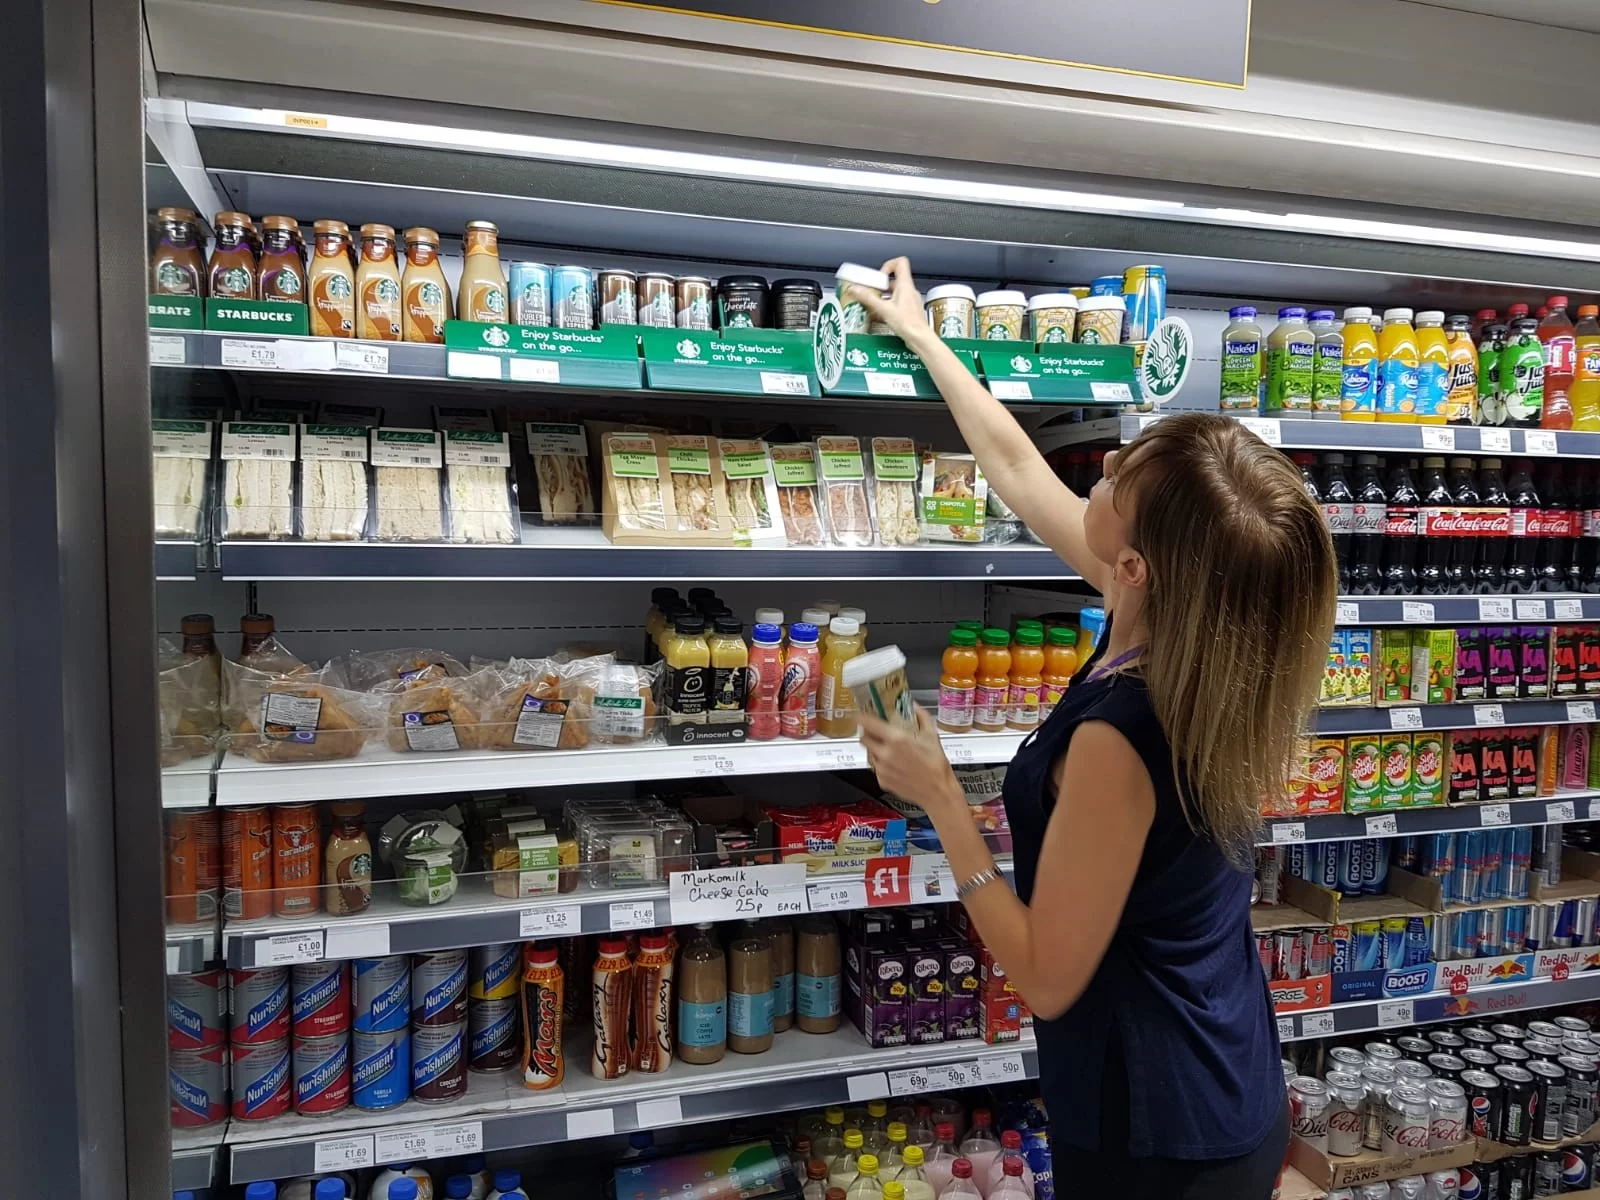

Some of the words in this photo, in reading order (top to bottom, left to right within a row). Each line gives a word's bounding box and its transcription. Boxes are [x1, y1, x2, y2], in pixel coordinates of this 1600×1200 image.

[217, 309, 294, 322] STARBUCKS
[521, 330, 550, 343] Enjoy
[539, 342, 557, 351] the
[710, 341, 736, 353] Enjoy
[251, 351, 276, 361] £1.79
[364, 354, 387, 364] £1.79
[727, 353, 742, 362] the
[877, 351, 901, 361] Enjoy
[1039, 357, 1063, 367] Enjoy
[894, 362, 907, 370] the
[1055, 367, 1070, 375] the
[1489, 643, 1515, 672] KA
[1522, 643, 1547, 672] KA
[1407, 714, 1421, 724] 50p
[696, 731, 730, 740] innocent
[1482, 746, 1508, 774] KA
[1512, 745, 1536, 773] KA
[1382, 821, 1396, 832] 49p
[1290, 830, 1305, 840] 49p
[832, 859, 851, 868] MILK
[1291, 847, 1303, 877] OOST
[1327, 844, 1337, 883] BOOST
[1351, 843, 1362, 881] BOOST
[681, 871, 746, 887] Markomilk
[873, 866, 901, 899] £1
[689, 887, 733, 902] Cheese
[738, 880, 769, 898] Cake
[831, 890, 849, 901] £1.00
[735, 898, 763, 914] 25p
[777, 902, 802, 912] EACH
[546, 913, 567, 923] £1.25
[634, 911, 653, 921] £1.49
[298, 941, 321, 952] £1.00
[951, 957, 975, 971] Ribena
[1334, 941, 1346, 974] OOST
[1540, 954, 1561, 968] Red
[1562, 951, 1580, 965] Bull
[880, 963, 904, 976] Ribena
[916, 961, 940, 974] Ribena
[1442, 965, 1464, 979] Red
[1464, 963, 1484, 976] Bull
[1342, 981, 1377, 991] ORIGINAL
[1388, 973, 1429, 990] BOOST
[1487, 996, 1507, 1010] Red
[1508, 993, 1528, 1006] Bull
[655, 979, 678, 1059] Galaxy
[1397, 1008, 1411, 1018] 49p
[593, 982, 612, 1068] Galaxy
[1278, 1024, 1294, 1035] 39p
[1318, 1019, 1333, 1030] 49p
[532, 986, 558, 1079] Mars
[353, 1047, 395, 1084] urishment
[414, 1037, 462, 1081] Nurishment
[1002, 1063, 1020, 1074] 50p
[910, 1076, 928, 1088] 69p
[948, 1071, 966, 1083] 50p
[1297, 1117, 1328, 1137] Diet
[1383, 1119, 1397, 1137] iet
[404, 1138, 426, 1150] £1.69
[456, 1133, 476, 1144] £1.69
[344, 1149, 367, 1159] £1.69
[1342, 1171, 1380, 1185] CANS
